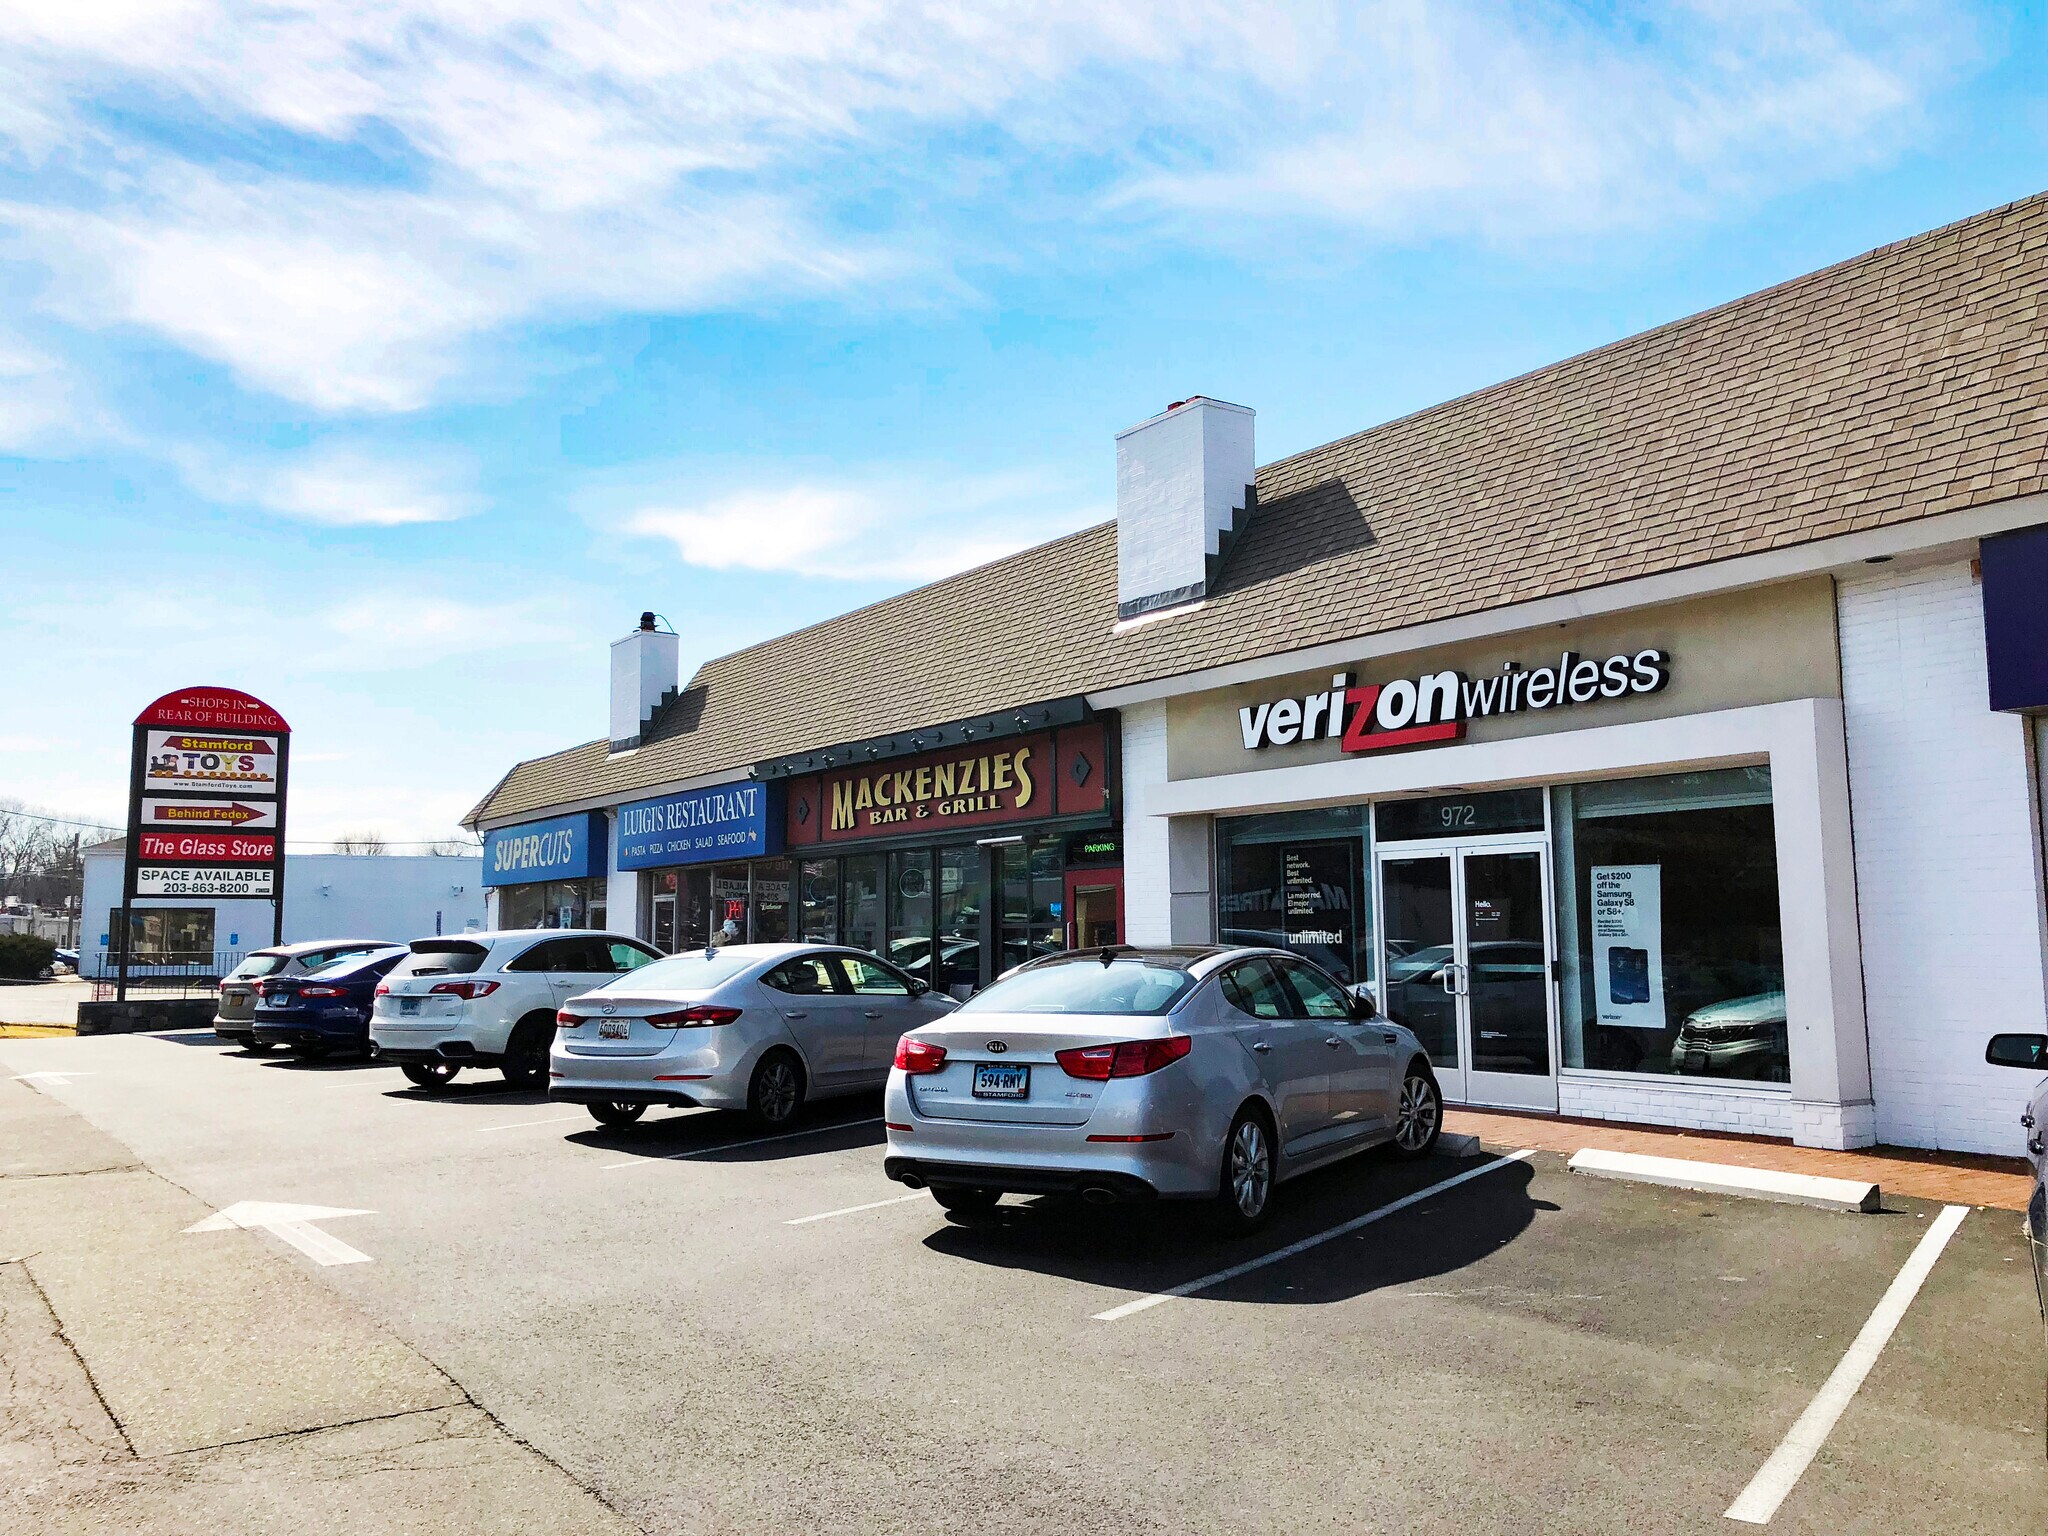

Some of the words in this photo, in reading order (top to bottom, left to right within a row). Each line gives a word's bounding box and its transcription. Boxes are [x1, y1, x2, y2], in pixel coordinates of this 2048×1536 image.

[189, 696, 230, 709] SHOPS
[233, 699, 248, 710] IN
[1238, 672, 1466, 753] verizon
[1463, 649, 1670, 719] wireless
[158, 709, 192, 721] REAR
[195, 711, 212, 722] OF
[216, 712, 277, 726] BUILDING
[181, 738, 254, 751] Stamford
[182, 752, 255, 772] TOYS
[831, 747, 1033, 831] MACKENZIES
[167, 808, 210, 819] Behind
[213, 808, 249, 820] Fedex
[623, 805, 664, 837] LUIGI'S
[666, 787, 758, 831] RESTAURANT
[869, 806, 908, 826] BAR
[915, 804, 930, 819] &
[938, 794, 1002, 816] GRILL
[1441, 805, 1476, 827] 972
[144, 837, 175, 855] The
[179, 838, 227, 856] Glass
[231, 839, 273, 857] Store
[494, 828, 573, 872] SUPERCUTS
[631, 845, 646, 857] PASTA
[649, 843, 664, 854] PIZZA
[667, 839, 691, 852] CHICKEN
[695, 836, 713, 849] SALAD
[717, 832, 746, 846] SEAFOOD
[1084, 842, 1115, 853] PARKING
[1286, 854, 1299, 862] Best
[1286, 861, 1311, 869] network.
[141, 870, 190, 881] SPACE
[194, 870, 271, 882] AVAILABLE
[1286, 869, 1299, 877] Best
[1596, 872, 1610, 880] Get
[1610, 872, 1632, 880] $200
[1286, 876, 1313, 885] unlimited.
[1596, 881, 1607, 889] off
[1608, 881, 1621, 889] the
[163, 882, 249, 894] 203-863-8200
[1293, 892, 1311, 901] mejor
[1311, 891, 1321, 899] red.
[1597, 890, 1632, 899] Samsung
[1293, 900, 1309, 909] mejor
[1474, 900, 1492, 908] Hello.
[1597, 899, 1624, 908] Galaxy
[1624, 898, 1635, 907] S8
[1287, 907, 1314, 915] unlimited.
[1606, 907, 1625, 916] S8+.
[1288, 929, 1343, 944] unlimited
[988, 1043, 1005, 1052] KIA
